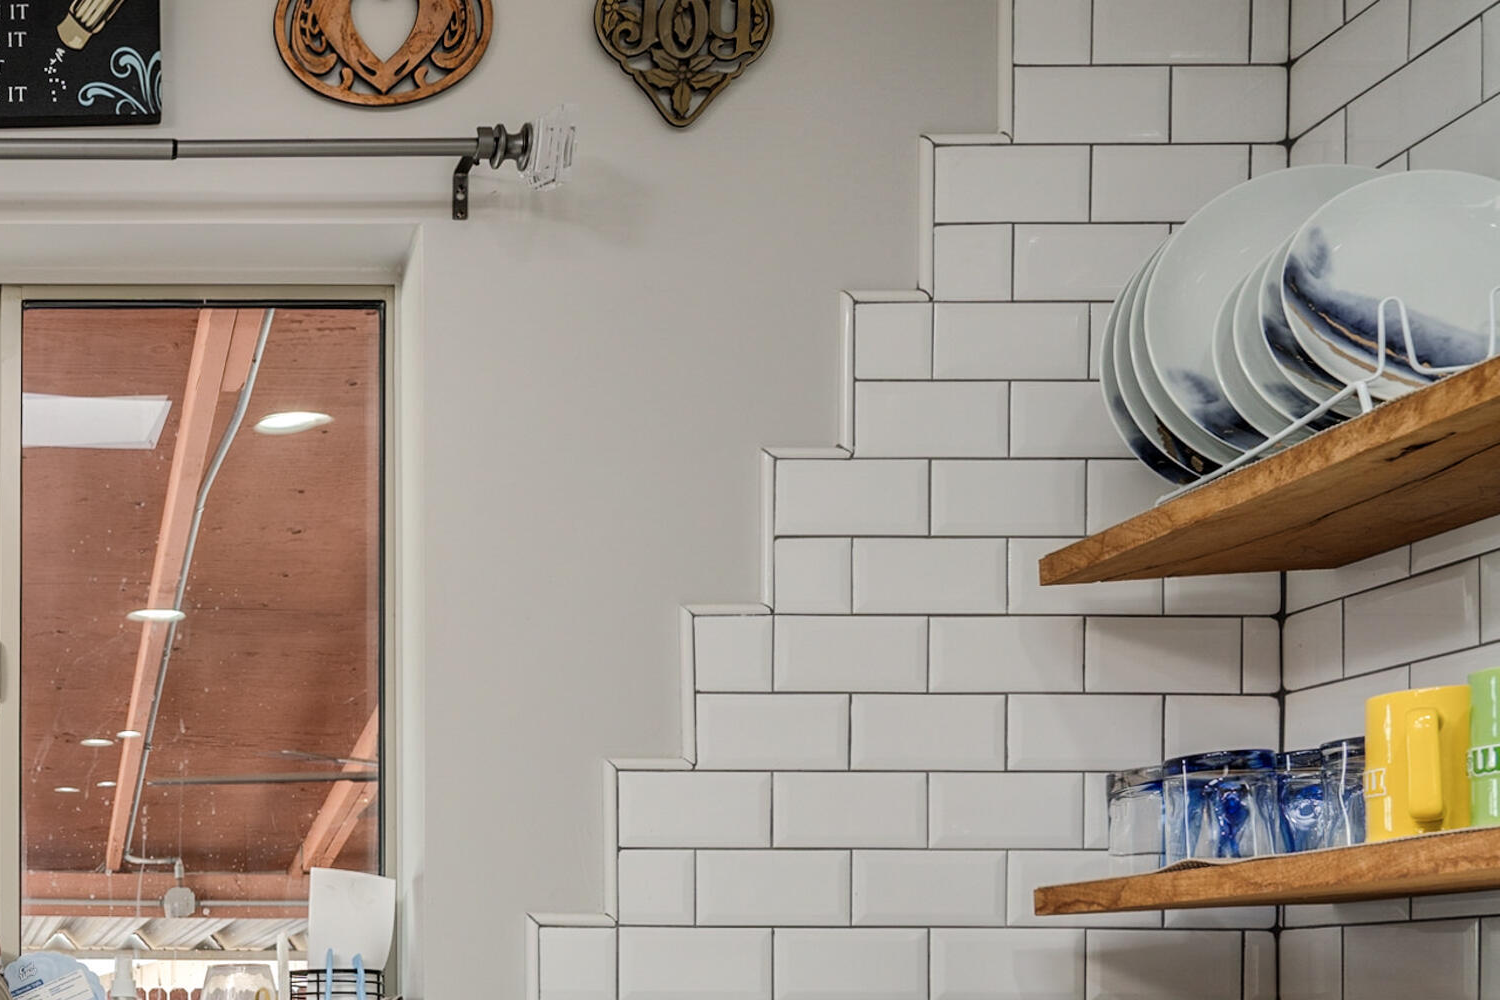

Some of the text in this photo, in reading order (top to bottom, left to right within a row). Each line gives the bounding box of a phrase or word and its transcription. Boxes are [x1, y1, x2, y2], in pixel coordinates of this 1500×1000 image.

[10, 3, 30, 20] IT
[8, 31, 28, 48] IT
[8, 86, 29, 103] IT
